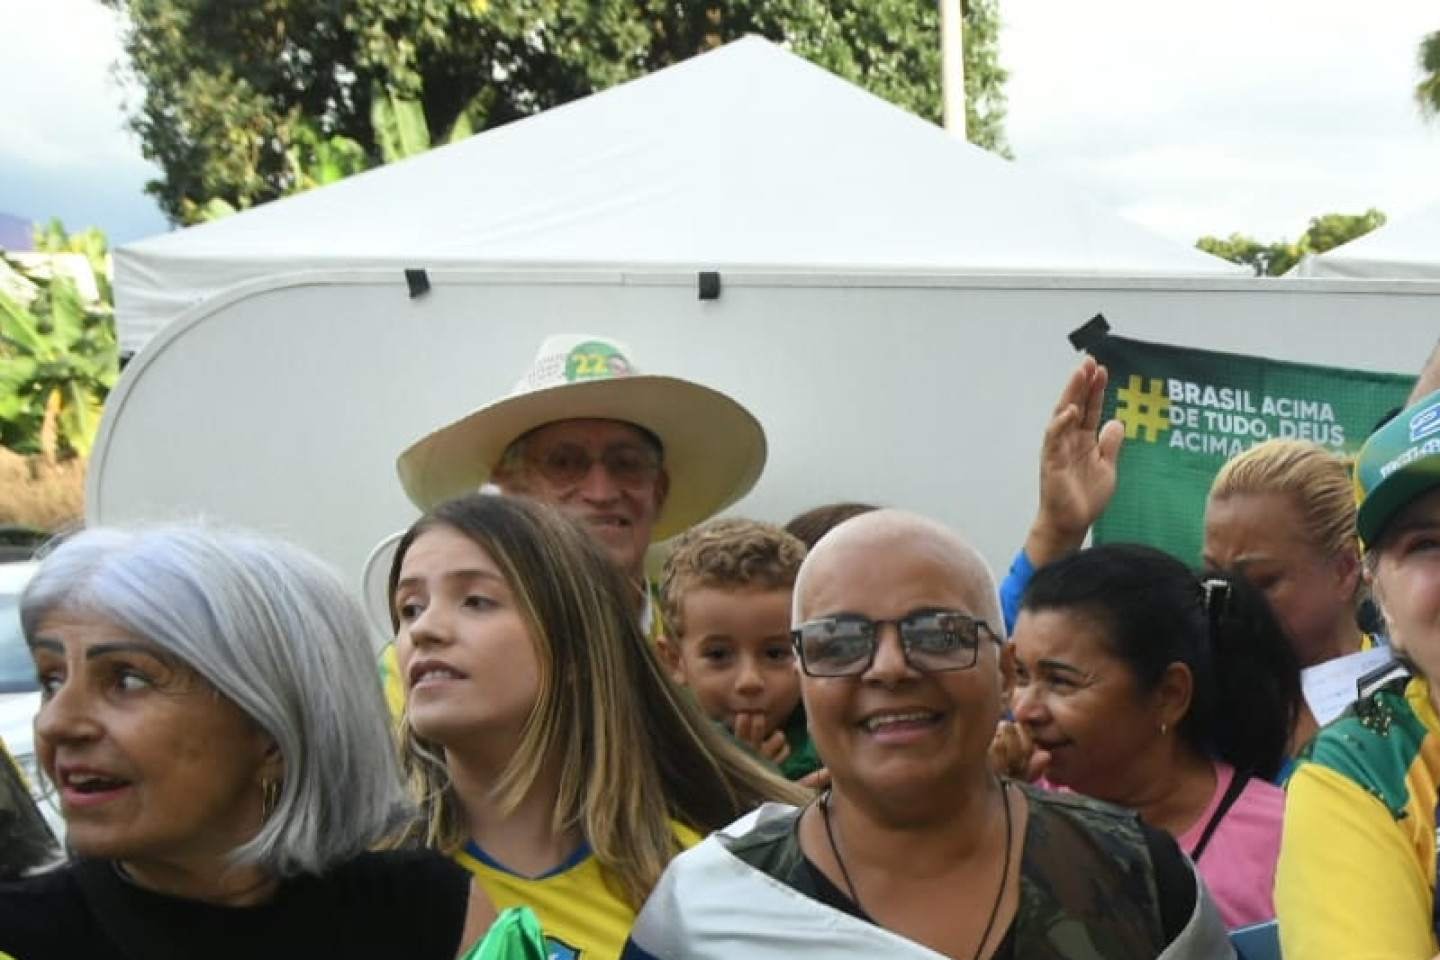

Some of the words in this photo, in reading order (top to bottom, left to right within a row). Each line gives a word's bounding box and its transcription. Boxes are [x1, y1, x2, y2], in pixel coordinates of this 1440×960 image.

[1168, 378, 1256, 414] BRASIL
[1262, 396, 1335, 423] ACIMA
[1169, 405, 1200, 428] DE
[1280, 419, 1346, 447] DEUS
[1169, 428, 1244, 460] ACIMA
